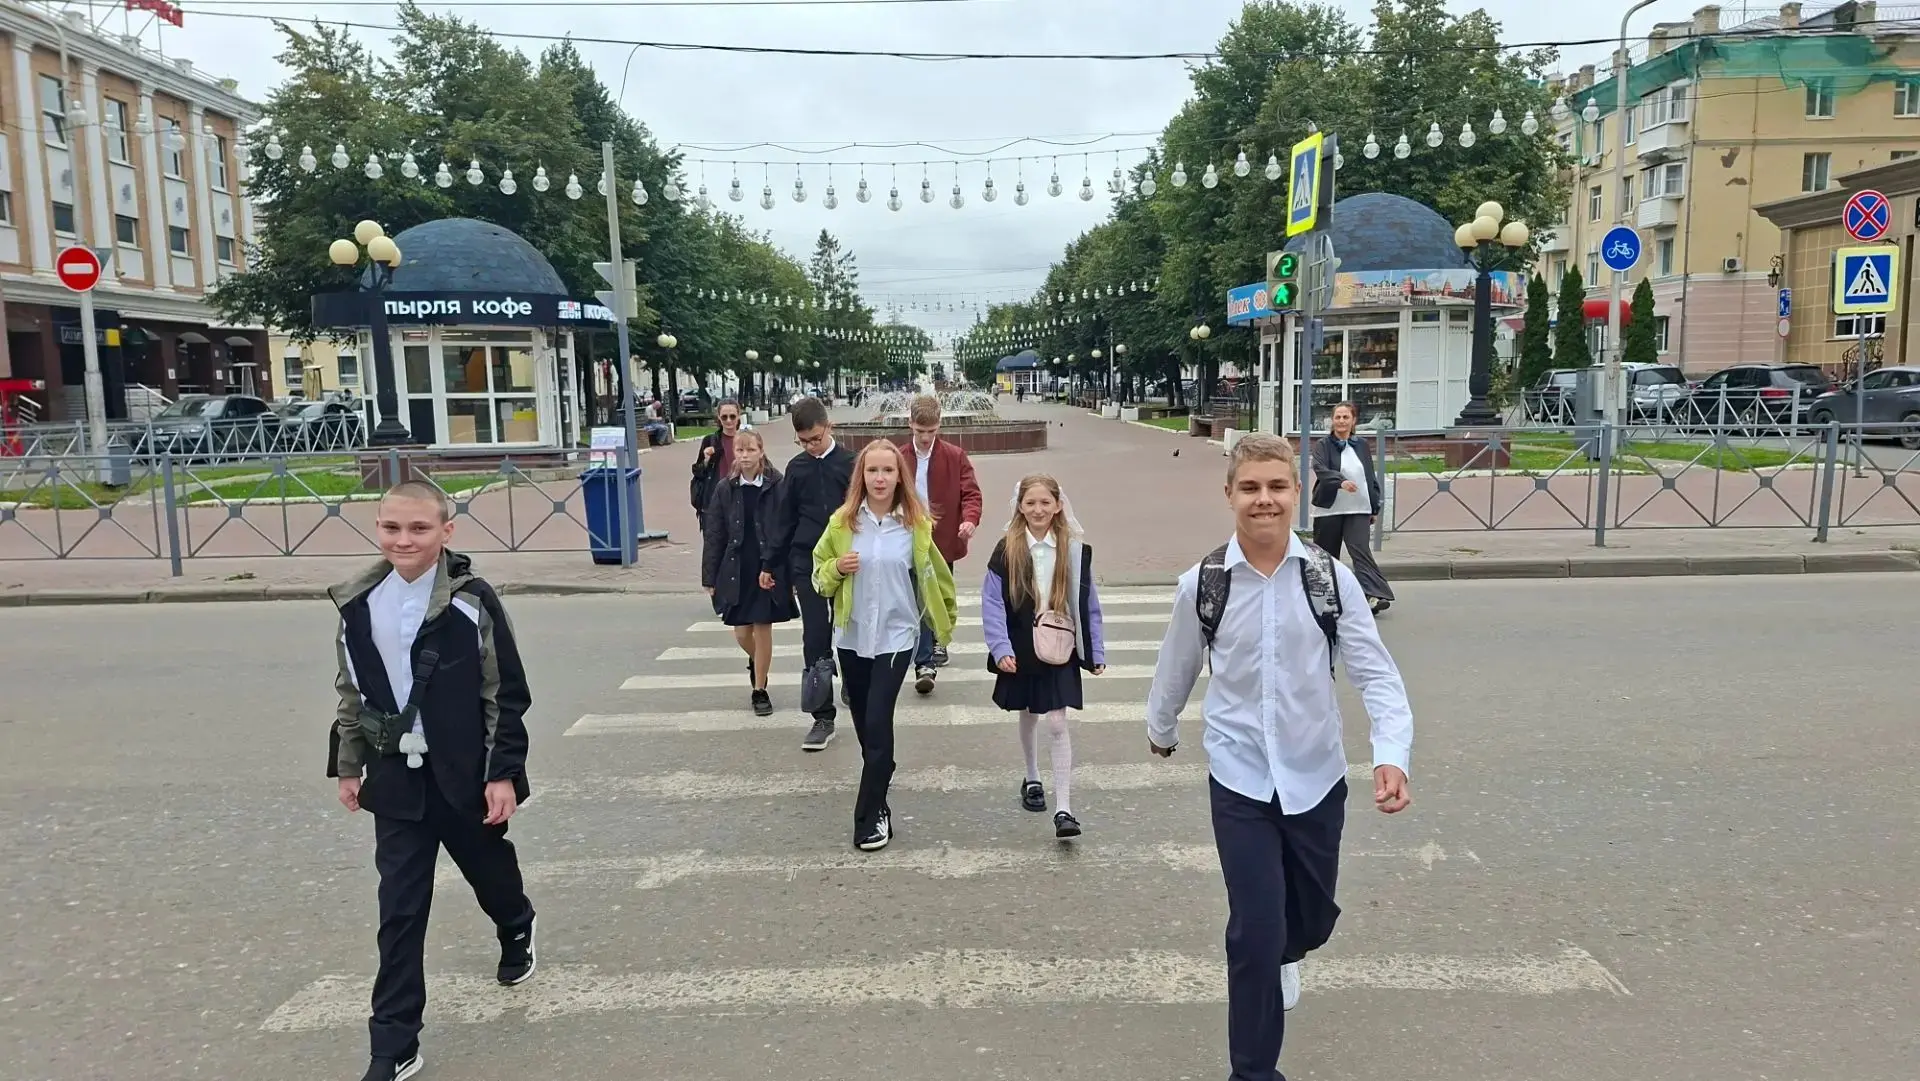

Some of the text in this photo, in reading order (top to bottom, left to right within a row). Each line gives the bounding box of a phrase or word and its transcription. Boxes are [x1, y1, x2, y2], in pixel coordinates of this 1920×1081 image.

[1281, 257, 1292, 275] 2
[384, 300, 461, 319] пырля
[472, 296, 533, 319] кофе
